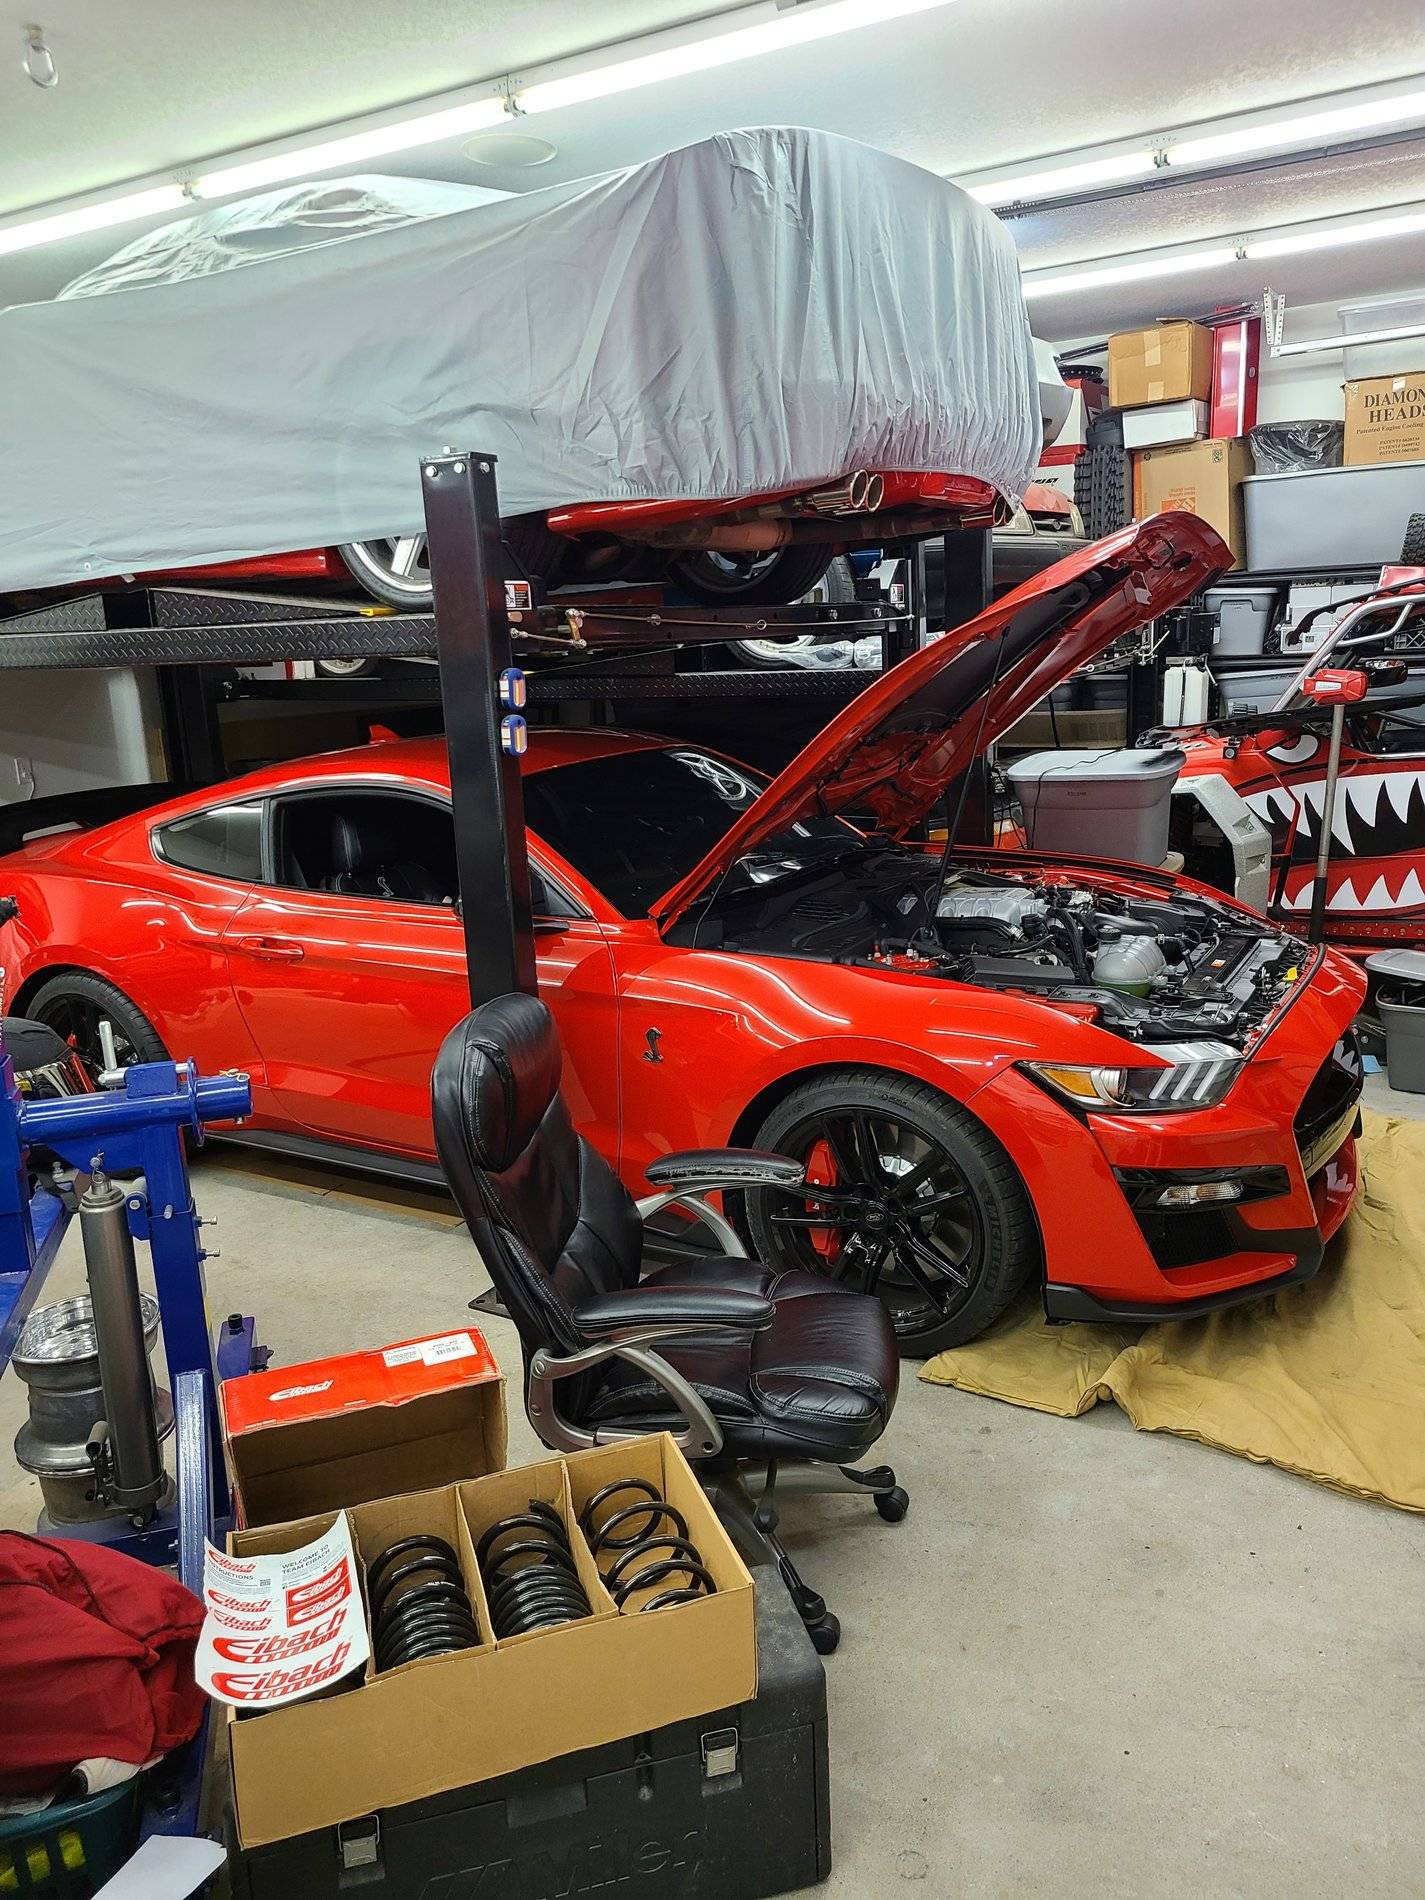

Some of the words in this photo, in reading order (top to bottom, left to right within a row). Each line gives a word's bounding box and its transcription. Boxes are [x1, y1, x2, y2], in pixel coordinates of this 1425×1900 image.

[208, 1549, 256, 1573] Eibach
[282, 1550, 318, 1569] WELCOME
[320, 1544, 329, 1552] TO
[282, 1564, 304, 1575] TEAM
[305, 1549, 330, 1566] EIBACH
[208, 1588, 272, 1612] Eibach
[213, 1609, 272, 1631] Eibach
[212, 1608, 347, 1664] Eibach
[211, 1641, 352, 1700] Eibach
